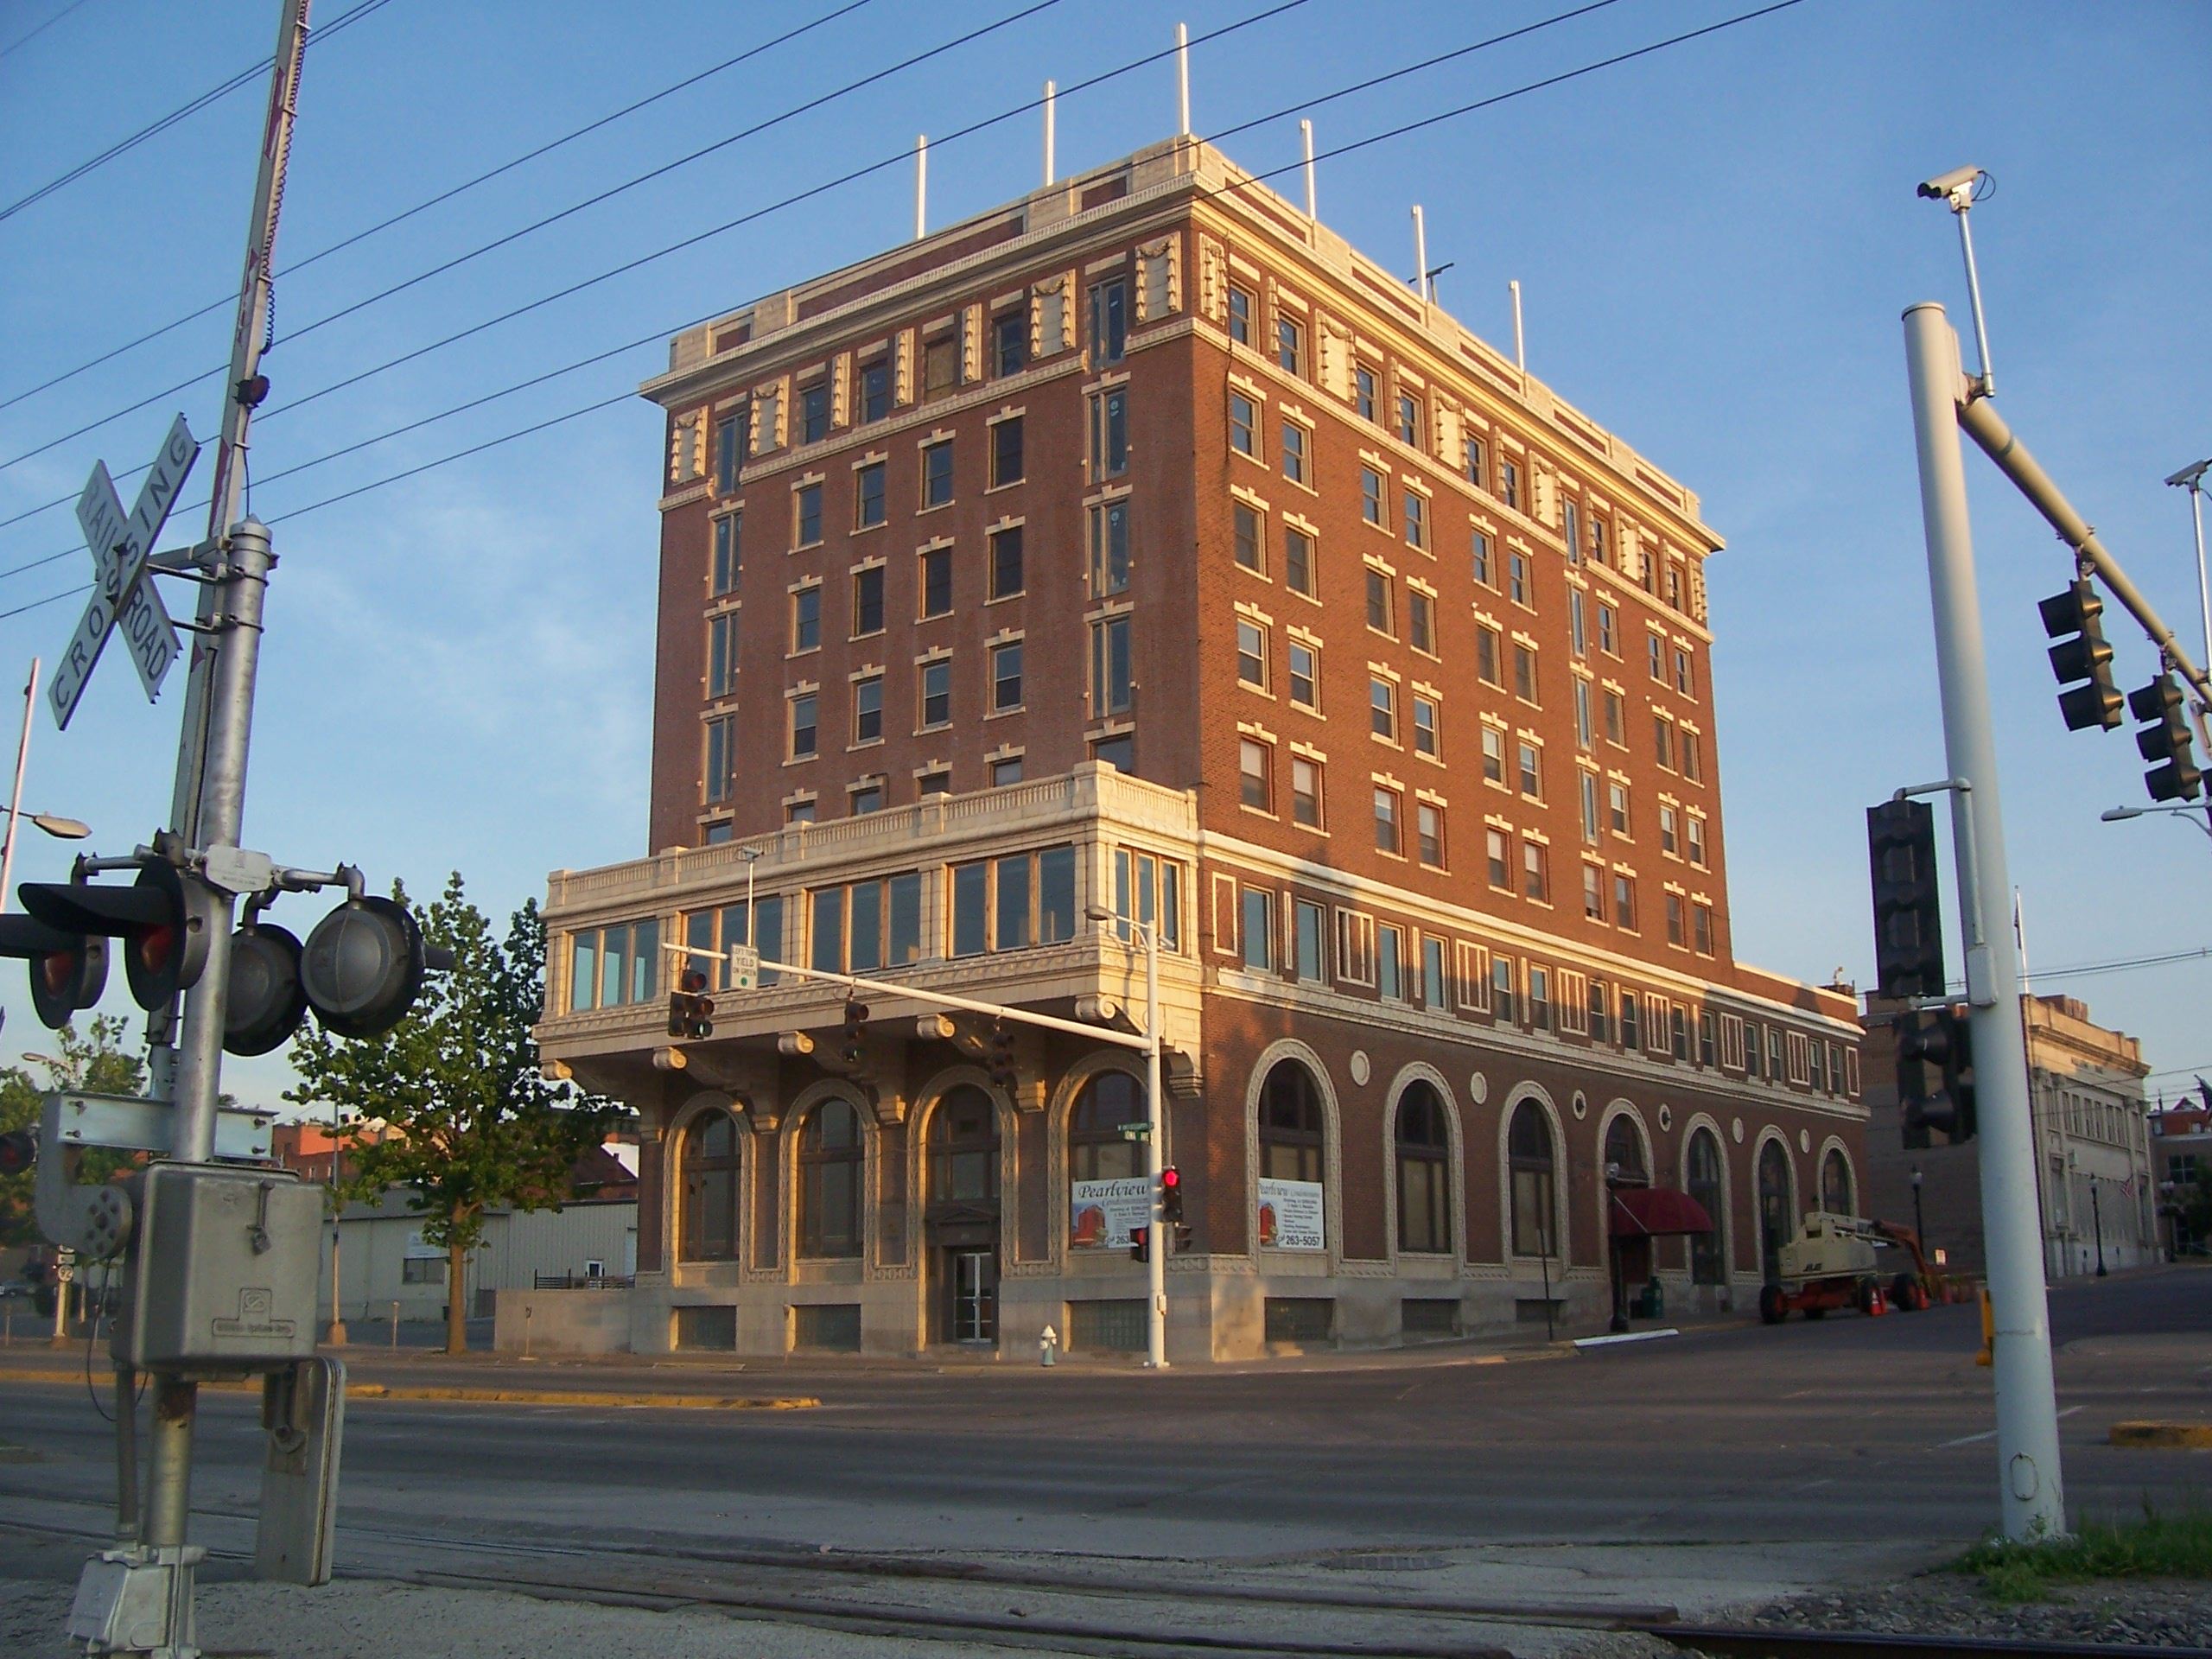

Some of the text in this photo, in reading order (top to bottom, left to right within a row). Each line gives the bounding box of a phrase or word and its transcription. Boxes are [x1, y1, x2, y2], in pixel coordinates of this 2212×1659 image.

[54, 438, 189, 710] CROSSING
[735, 957, 755, 968] YIELD
[741, 968, 757, 976] GREEN
[1078, 1180, 1151, 1198] Pearlview
[1286, 1235, 1321, 1246] 263-5057
